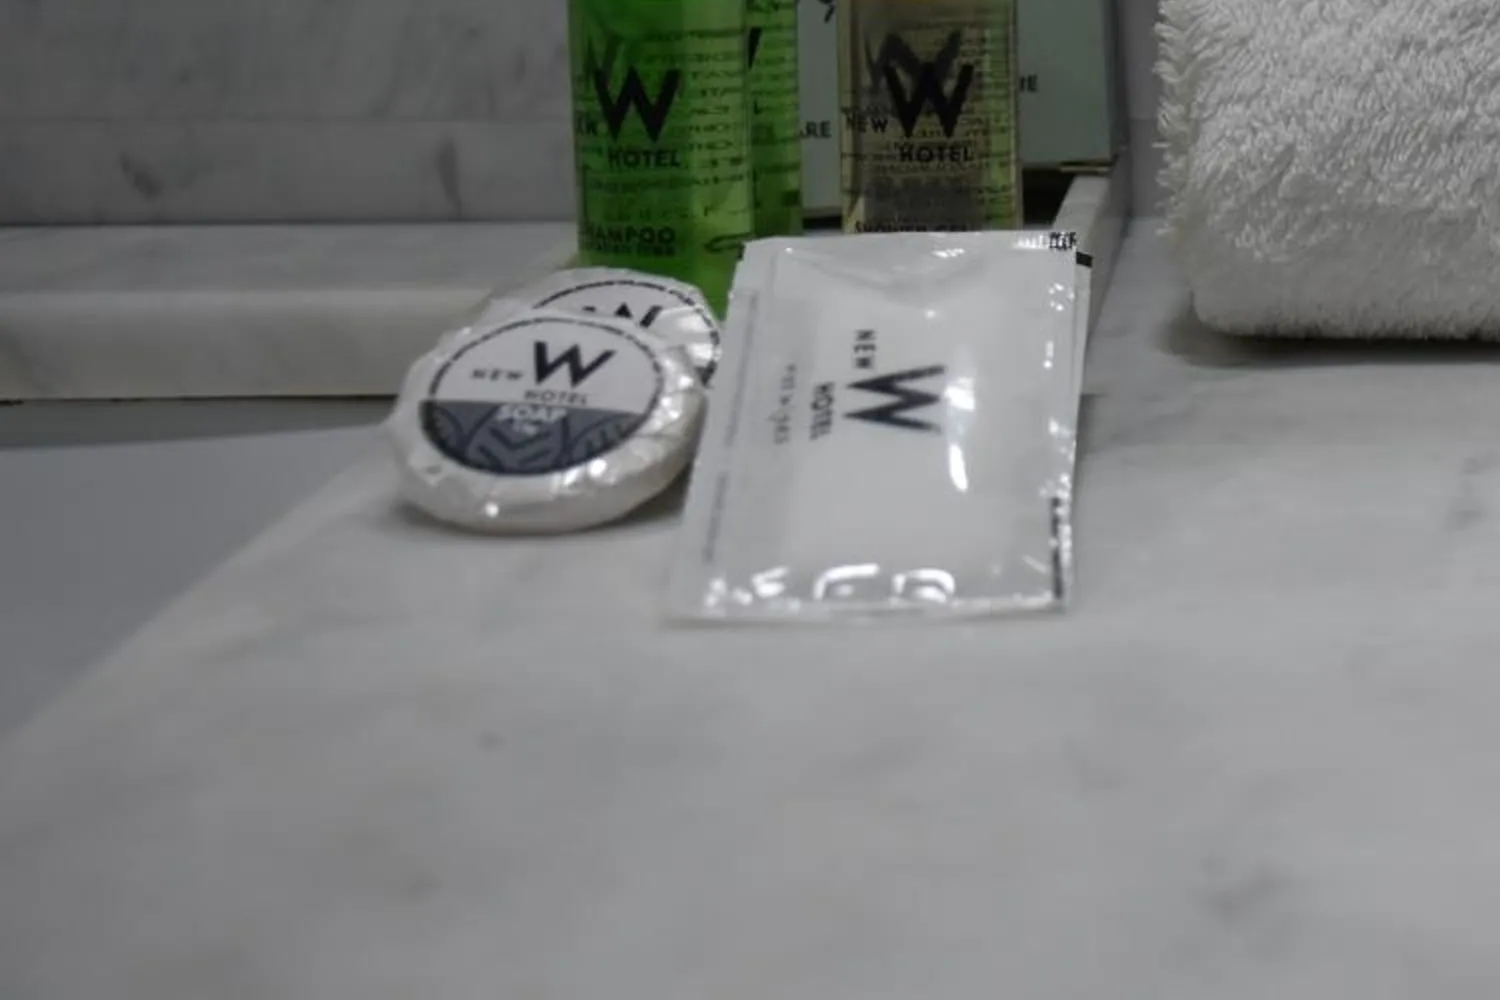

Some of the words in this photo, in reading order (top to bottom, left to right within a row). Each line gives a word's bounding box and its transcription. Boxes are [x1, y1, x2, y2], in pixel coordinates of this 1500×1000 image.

[592, 65, 681, 143] W
[847, 112, 889, 134] NEW
[884, 64, 975, 138] W
[608, 148, 681, 169] HOTEL
[899, 145, 974, 163] HOTEL
[471, 368, 524, 382] NEW
[533, 341, 618, 388] W
[853, 329, 877, 370] NEW
[524, 390, 588, 405] HOTEL
[809, 381, 836, 440] HOTEL
[843, 364, 946, 433] W
